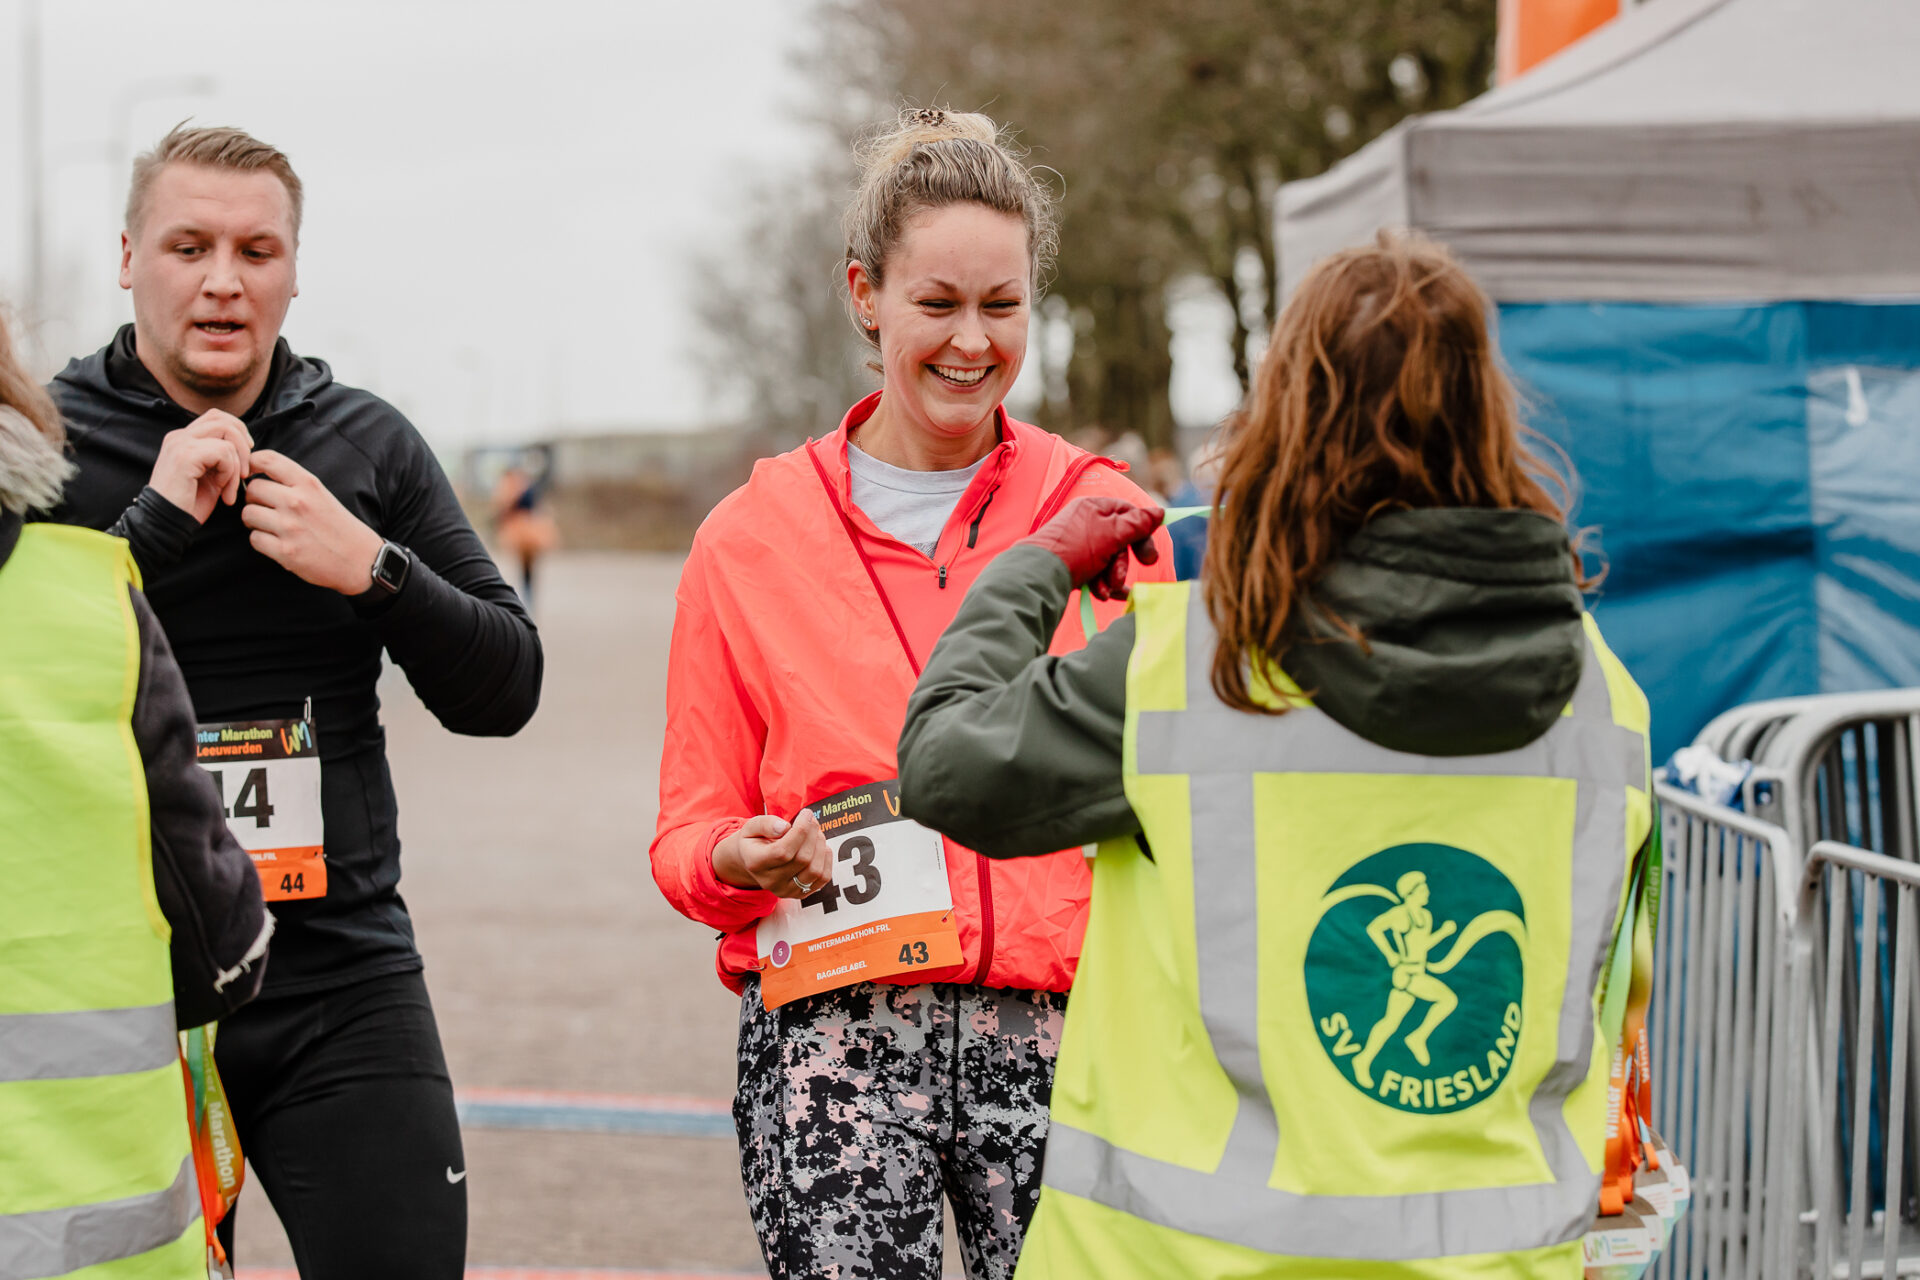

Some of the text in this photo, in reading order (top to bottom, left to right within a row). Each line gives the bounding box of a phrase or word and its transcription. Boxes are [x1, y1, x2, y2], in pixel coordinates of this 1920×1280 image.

[197, 727, 274, 744] nter Marathon
[196, 742, 263, 757] Leeuwarden
[211, 768, 274, 828] 4
[822, 793, 872, 817] Marathon
[819, 811, 862, 832] uwarden
[280, 872, 305, 894] 44
[807, 924, 892, 953] WINTERMARATHON.FRL
[898, 941, 930, 966] 43
[816, 960, 868, 981] BAGAGELABEL
[1319, 1001, 1522, 1109] SV FRIESLAND
[208, 1101, 236, 1189] Marathon
